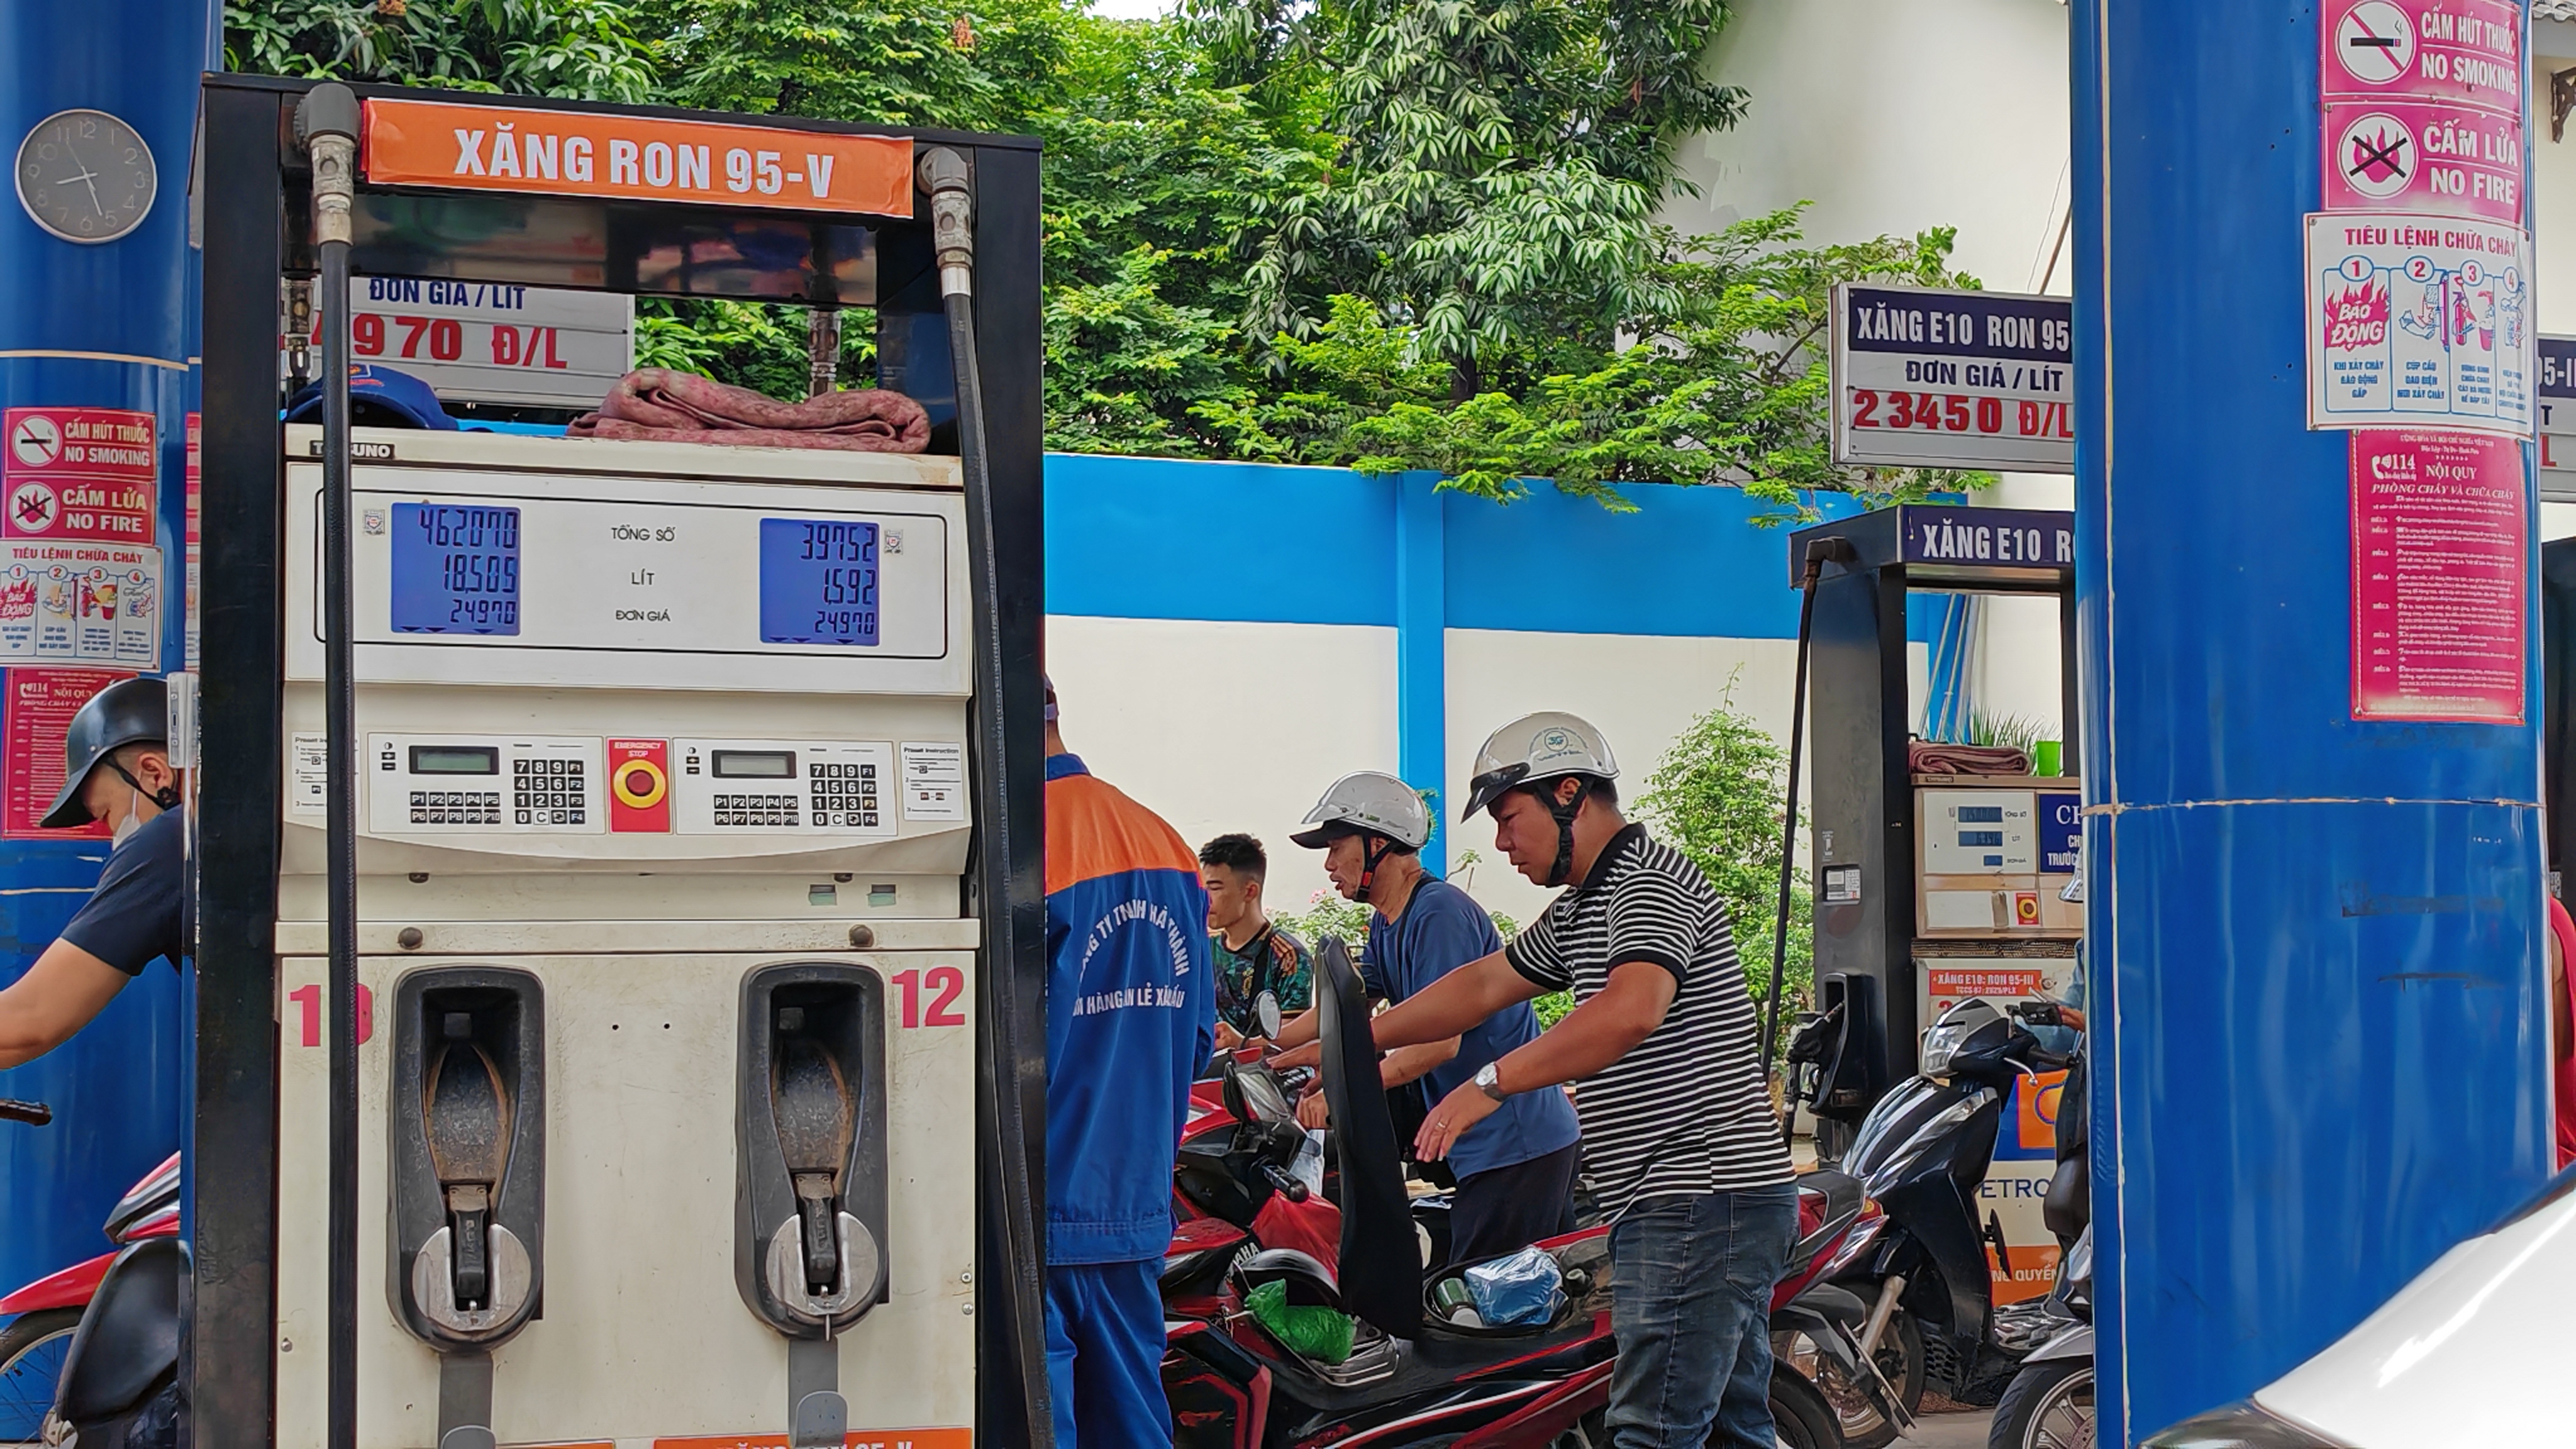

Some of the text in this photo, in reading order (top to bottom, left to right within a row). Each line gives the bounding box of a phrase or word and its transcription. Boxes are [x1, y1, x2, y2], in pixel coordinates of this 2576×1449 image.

[2421, 2, 2453, 42] CẤM
[2458, 12, 2482, 47] HÚT
[2422, 53, 2516, 95] NO SMOKING
[80, 120, 96, 138] 12
[2424, 119, 2518, 167] CẤM LỬA
[125, 147, 138, 164] 2
[454, 121, 835, 199] XĂNG RON 95-V
[2431, 168, 2515, 204] NO FIRE
[105, 211, 118, 227] 5
[2345, 225, 2387, 245] TIÊU
[2394, 225, 2439, 249] LỆNH
[2351, 261, 2360, 277] 1
[2414, 262, 2426, 277] 2
[2468, 265, 2477, 281] 3
[1857, 302, 2069, 352] XĂNG E10 RON 95
[491, 325, 567, 369] Đ/L
[1906, 360, 1956, 385] ĐƠN
[1966, 362, 2006, 389] GIÁ
[2029, 365, 2063, 392] LÍT
[65, 416, 89, 439] CẤM
[92, 421, 113, 440] HÚT
[65, 447, 150, 467] NO SMOKING
[313, 441, 391, 458] TUNO
[2426, 462, 2448, 480] NỘI
[2453, 466, 2477, 480] QUY
[63, 484, 147, 510] CẤM LỬA
[67, 513, 143, 532] NO FIRE
[420, 509, 518, 548] 462070
[656, 526, 676, 541] SỐ
[1923, 518, 1990, 560] XĂNG
[1997, 527, 2041, 562] E10
[801, 524, 876, 562] 39752
[14, 567, 21, 577] 1
[53, 568, 61, 578] 2
[94, 569, 102, 579] 3
[631, 569, 655, 586] LÍT
[450, 599, 516, 624] 24970
[616, 608, 670, 622] ĐƠN GIÁ
[815, 611, 875, 635] 24970
[516, 762, 562, 773] 7 8 9
[813, 766, 855, 777] 7 8 9
[517, 778, 562, 789] 4 5 6
[814, 782, 857, 793] 4 5 6
[412, 796, 499, 804] P1 P2 P3 P4 P5
[518, 795, 563, 806] 1 2 3
[815, 797, 857, 809] 1 2 3
[412, 812, 481, 821] P6 P7 P8 P9
[519, 811, 547, 823] 0 C
[816, 814, 842, 824] 0 C
[891, 966, 965, 1028] 12
[1981, 1179, 2050, 1198] ETRO
[1235, 1242, 1259, 1265] AHA
